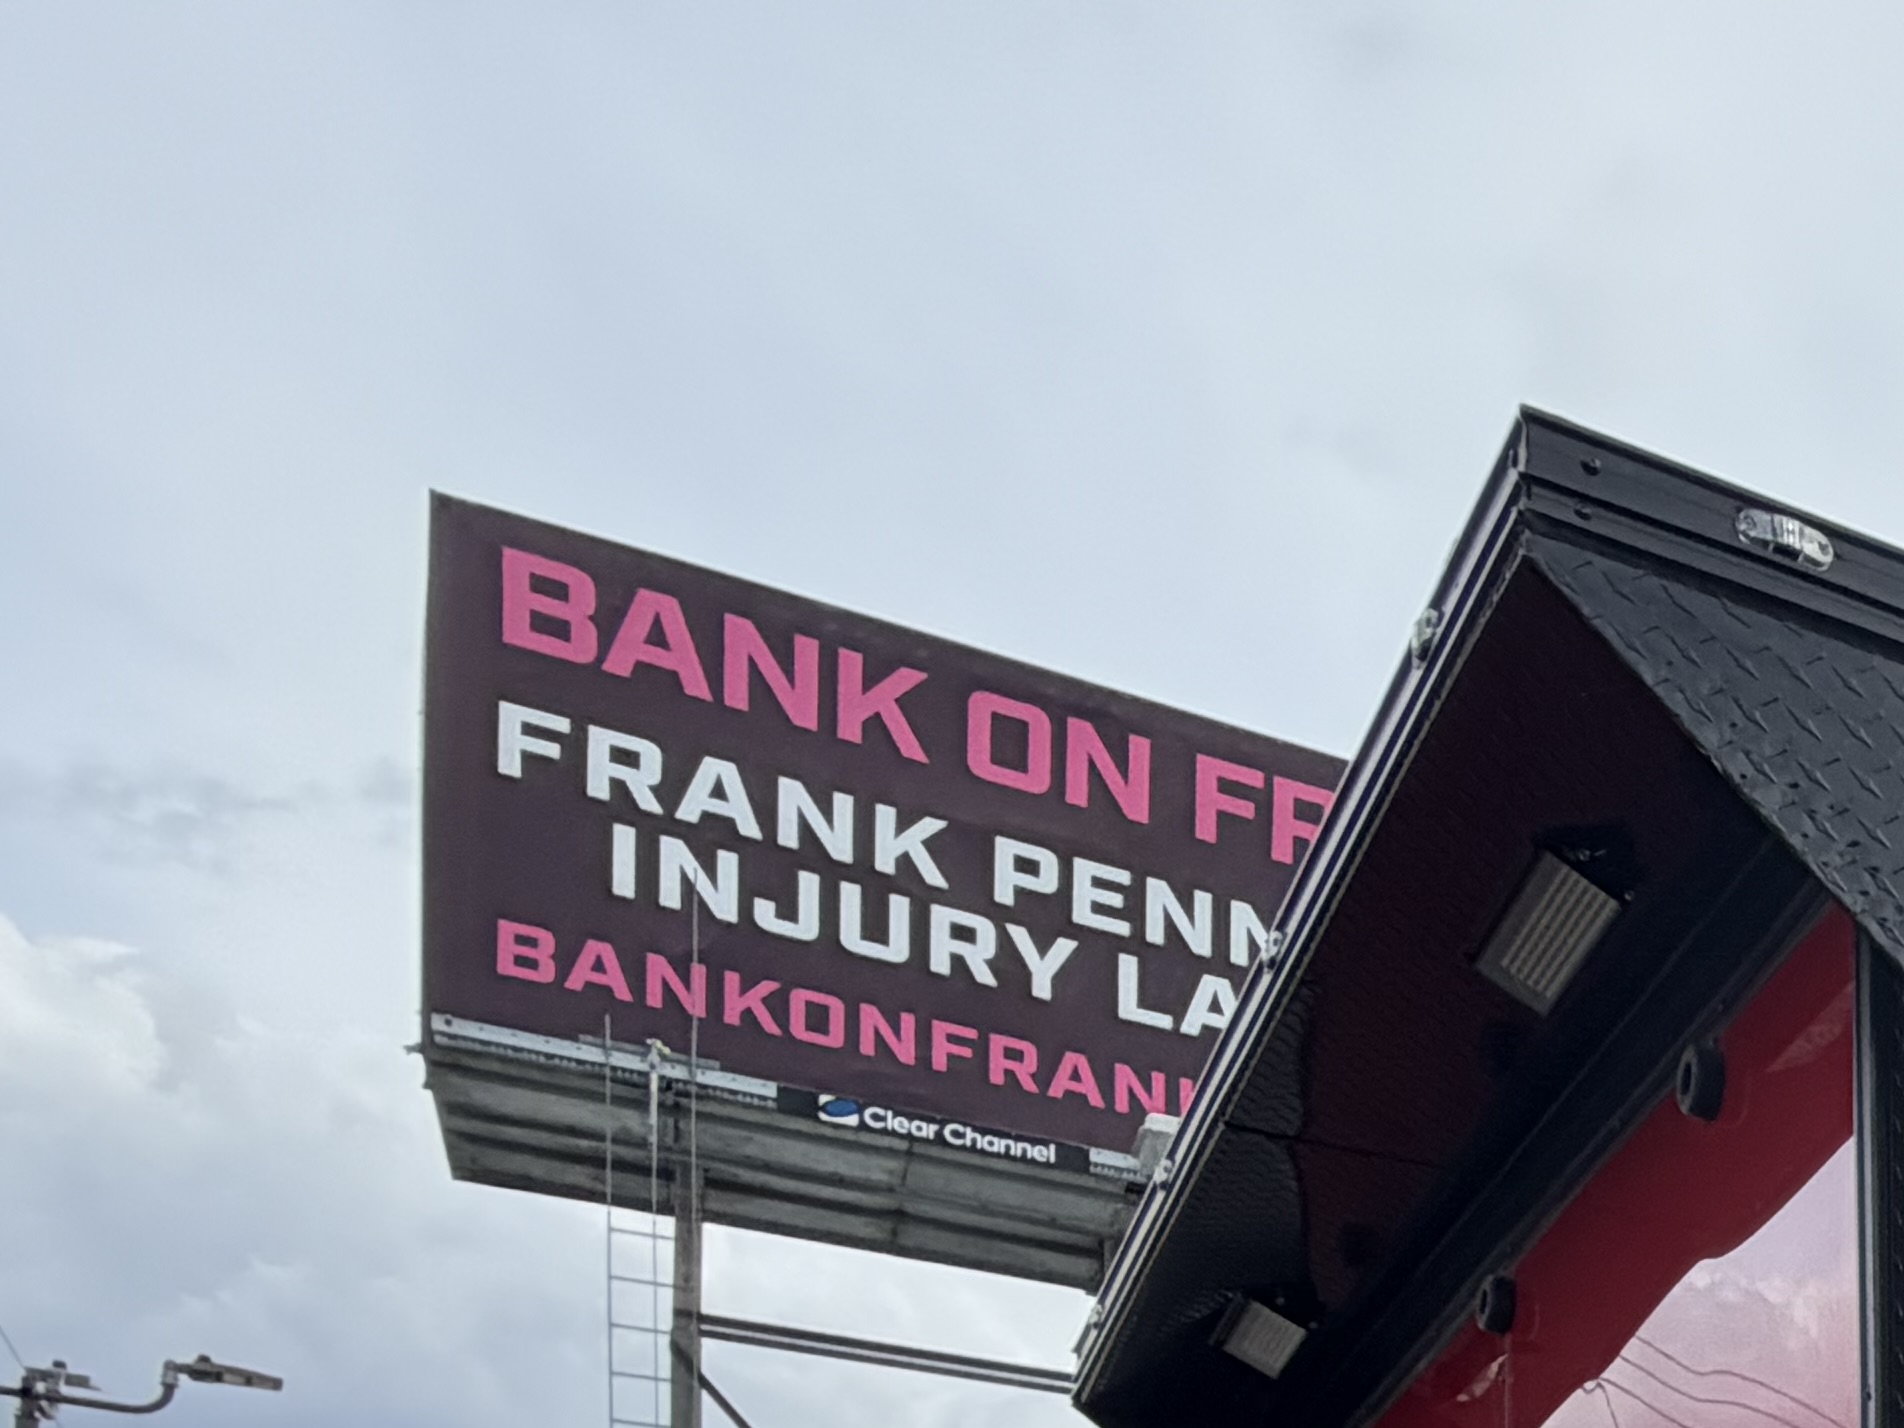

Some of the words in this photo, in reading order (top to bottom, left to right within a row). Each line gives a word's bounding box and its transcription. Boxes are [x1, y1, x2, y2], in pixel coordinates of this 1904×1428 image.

[500, 545, 929, 764] BANK
[966, 690, 1151, 825] ON
[496, 700, 949, 890] FRANK
[610, 824, 1079, 1002] INJURY
[862, 1106, 940, 1141] Clear
[942, 1122, 1057, 1164] Channel
